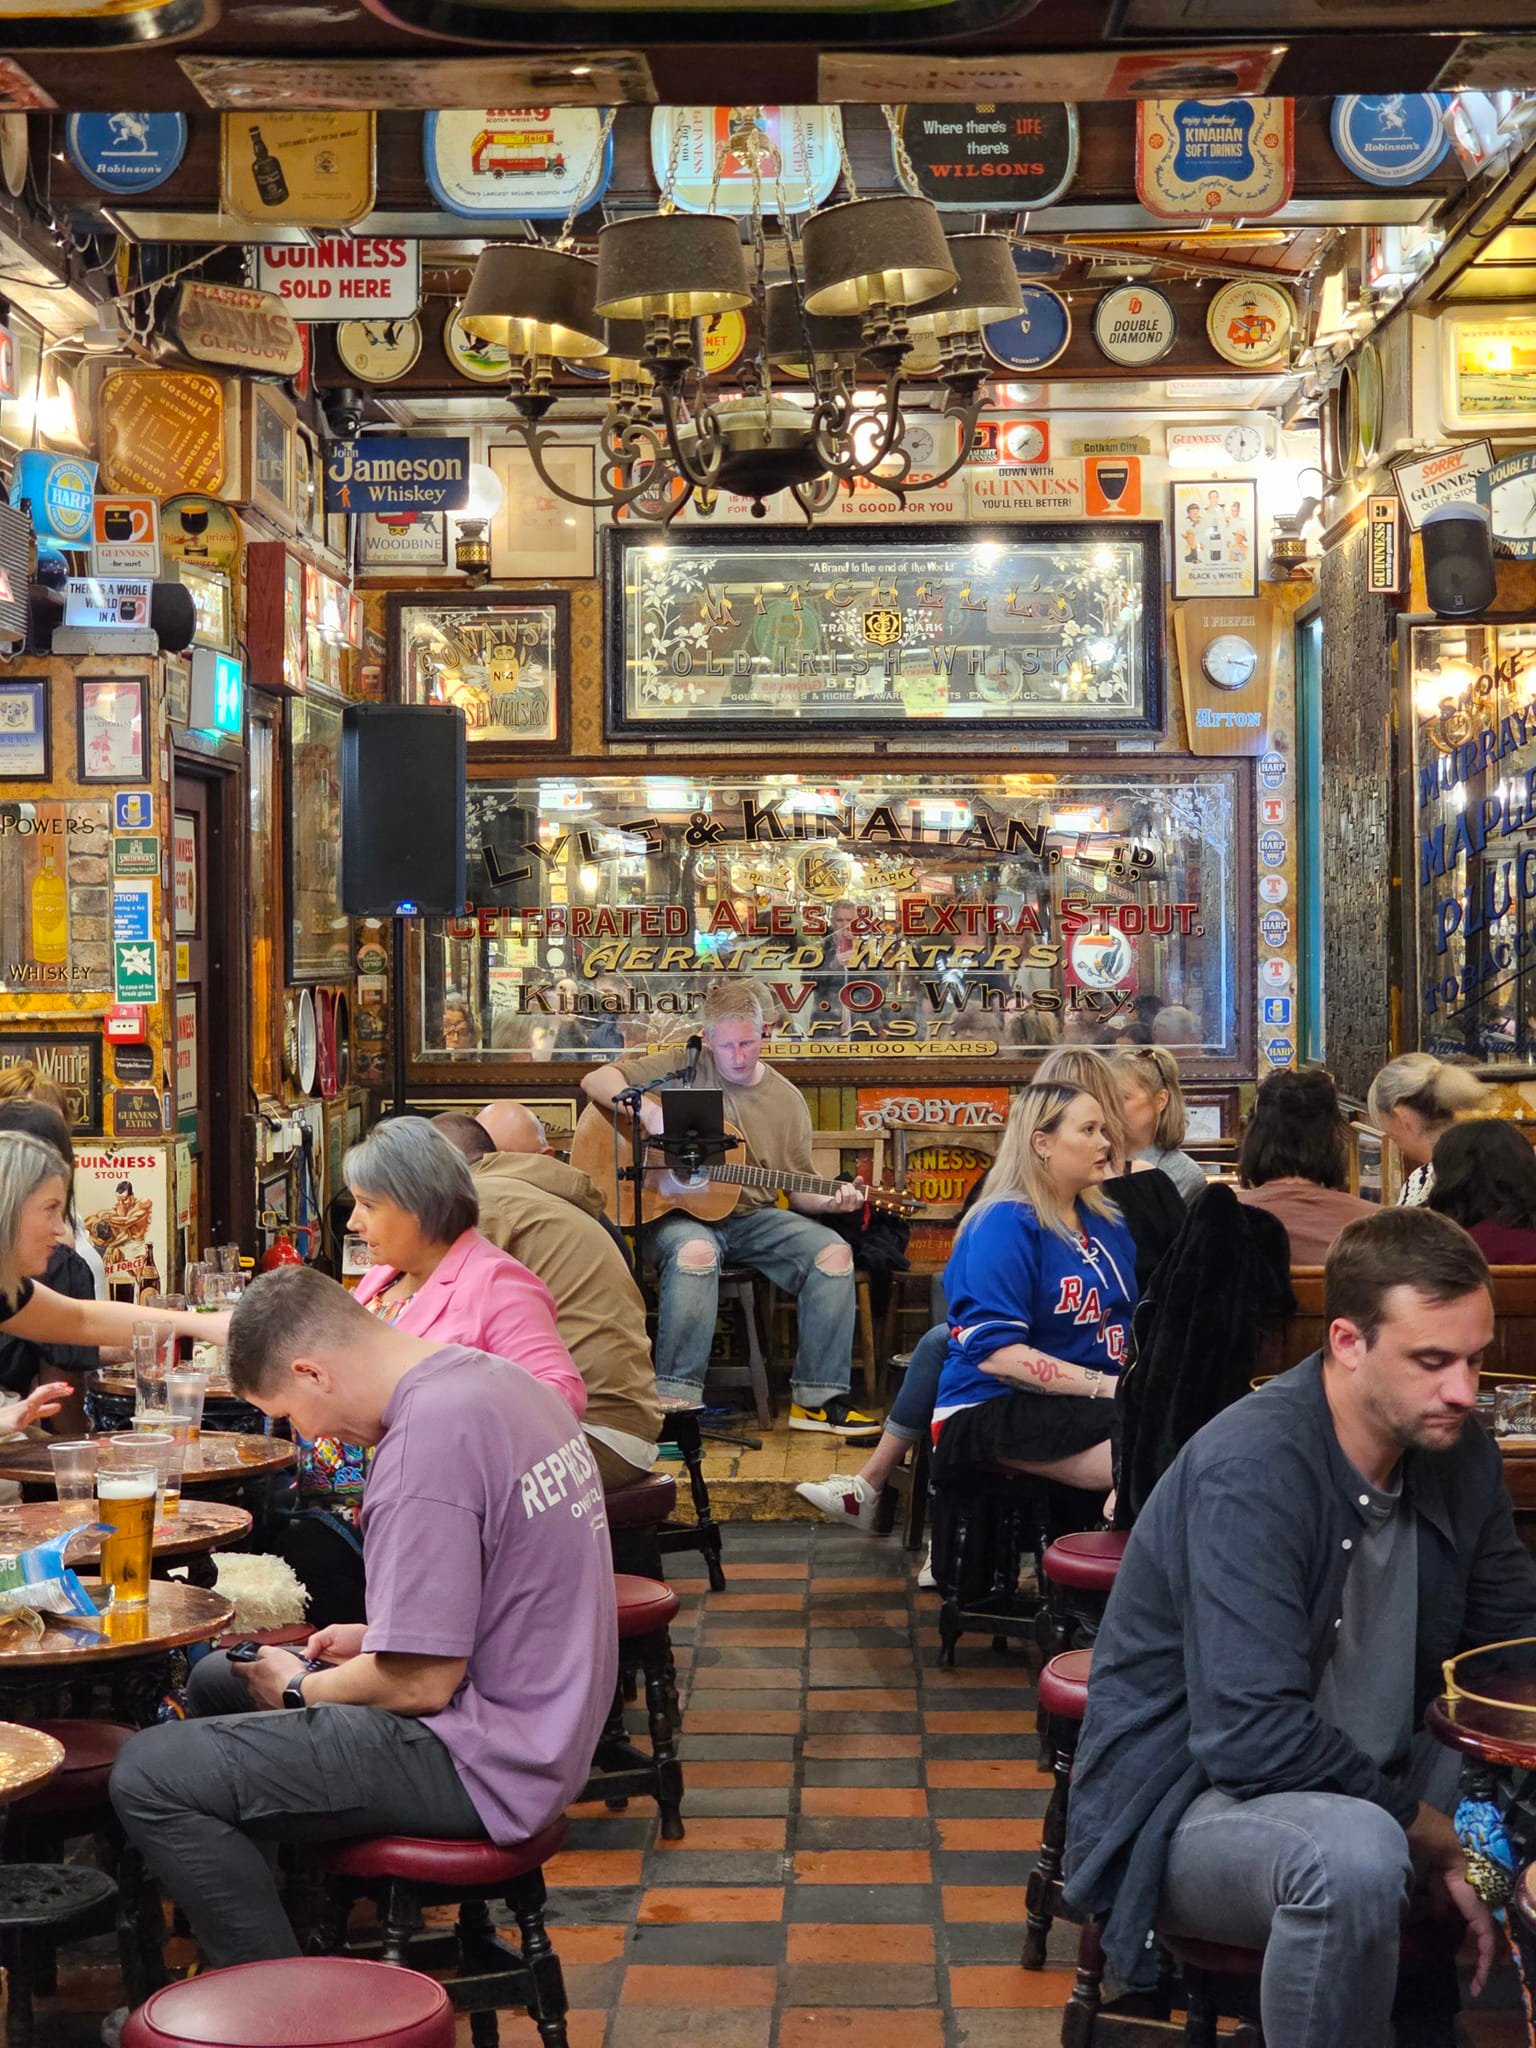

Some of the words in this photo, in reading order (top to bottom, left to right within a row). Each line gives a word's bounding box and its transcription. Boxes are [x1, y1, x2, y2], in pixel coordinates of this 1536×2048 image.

[923, 120, 963, 135] Where
[966, 120, 1007, 135] there's
[1016, 118, 1042, 135] LIFE
[1185, 128, 1243, 142] KINAHAN
[967, 142, 1009, 155] there's
[1185, 144, 1208, 157] SOFT
[1210, 143, 1243, 157] DRINKS
[1364, 141, 1420, 152] Robinson's
[97, 163, 162, 175] Robinson's
[929, 163, 1045, 177] WILSONS
[263, 239, 408, 269] GUINNESS
[279, 279, 332, 299] SOLD
[339, 278, 392, 298] HERE
[191, 284, 264, 309] HARRY
[180, 301, 293, 346] JARVIS
[1114, 319, 1159, 332] DOUBLE
[1108, 330, 1164, 345] DIAMOND
[201, 333, 289, 362] GLASGOW
[1173, 433, 1222, 445] GUINNESS
[331, 447, 359, 459] John
[1083, 442, 1116, 453] Gotham
[1119, 442, 1138, 454] City
[328, 440, 463, 483] Jameson
[1421, 452, 1465, 479] SORRY
[999, 468, 1027, 477] DOWN
[1029, 467, 1054, 477] WITH
[1487, 458, 1529, 487] DOUBLE
[368, 484, 447, 505] Whiskey
[974, 478, 1080, 497] GUINNESS
[52, 487, 91, 511] HARP
[982, 499, 1010, 508] YOU'LL
[1013, 499, 1034, 508] FEEL
[1036, 498, 1072, 508] BETTER!
[841, 503, 854, 513] IS
[858, 503, 896, 513] GOOD
[930, 502, 954, 512] YOU
[366, 536, 441, 550] WOODBINE
[101, 550, 150, 558] GUINNESS
[1373, 522, 1387, 587] GUINNESS
[820, 563, 849, 573] Brand
[861, 563, 876, 573] the
[879, 563, 897, 572] end
[911, 562, 926, 572] the
[109, 585, 114, 594] A
[117, 585, 147, 595] WHOLE
[99, 612, 108, 622] IN
[110, 613, 116, 622] A
[1211, 616, 1256, 627] PREFER
[905, 623, 943, 632] MARK
[420, 617, 542, 679] COWAN'S
[671, 649, 751, 676] OLD
[779, 646, 902, 676] IRISH
[488, 699, 549, 727] WHISKY
[1195, 708, 1262, 727] AFTON
[1261, 763, 1285, 772] HARP
[1265, 801, 1282, 820] T
[1, 815, 95, 836] POWER'S
[481, 817, 664, 888] LYLE
[685, 811, 728, 848] &
[1261, 842, 1285, 850] HARP
[743, 870, 780, 884] TRADE
[869, 871, 908, 884] MARK
[1267, 879, 1281, 893] T
[706, 898, 827, 936] ALES
[850, 904, 883, 935] &
[901, 898, 1042, 936] EXTRA
[1060, 898, 1205, 937] STOUT,
[1263, 921, 1287, 930] HARP
[583, 941, 825, 979] AERATED
[9, 964, 93, 982] WHISKEY
[1270, 962, 1284, 976] T
[810, 1043, 861, 1054] OVER
[870, 1043, 905, 1054] 100
[1269, 1046, 1294, 1056] HARP
[36, 1047, 88, 1084] WHITE
[118, 1111, 158, 1120] GUINNESS
[126, 1120, 152, 1128] EXTRA
[116, 1258, 143, 1274] FORCE
